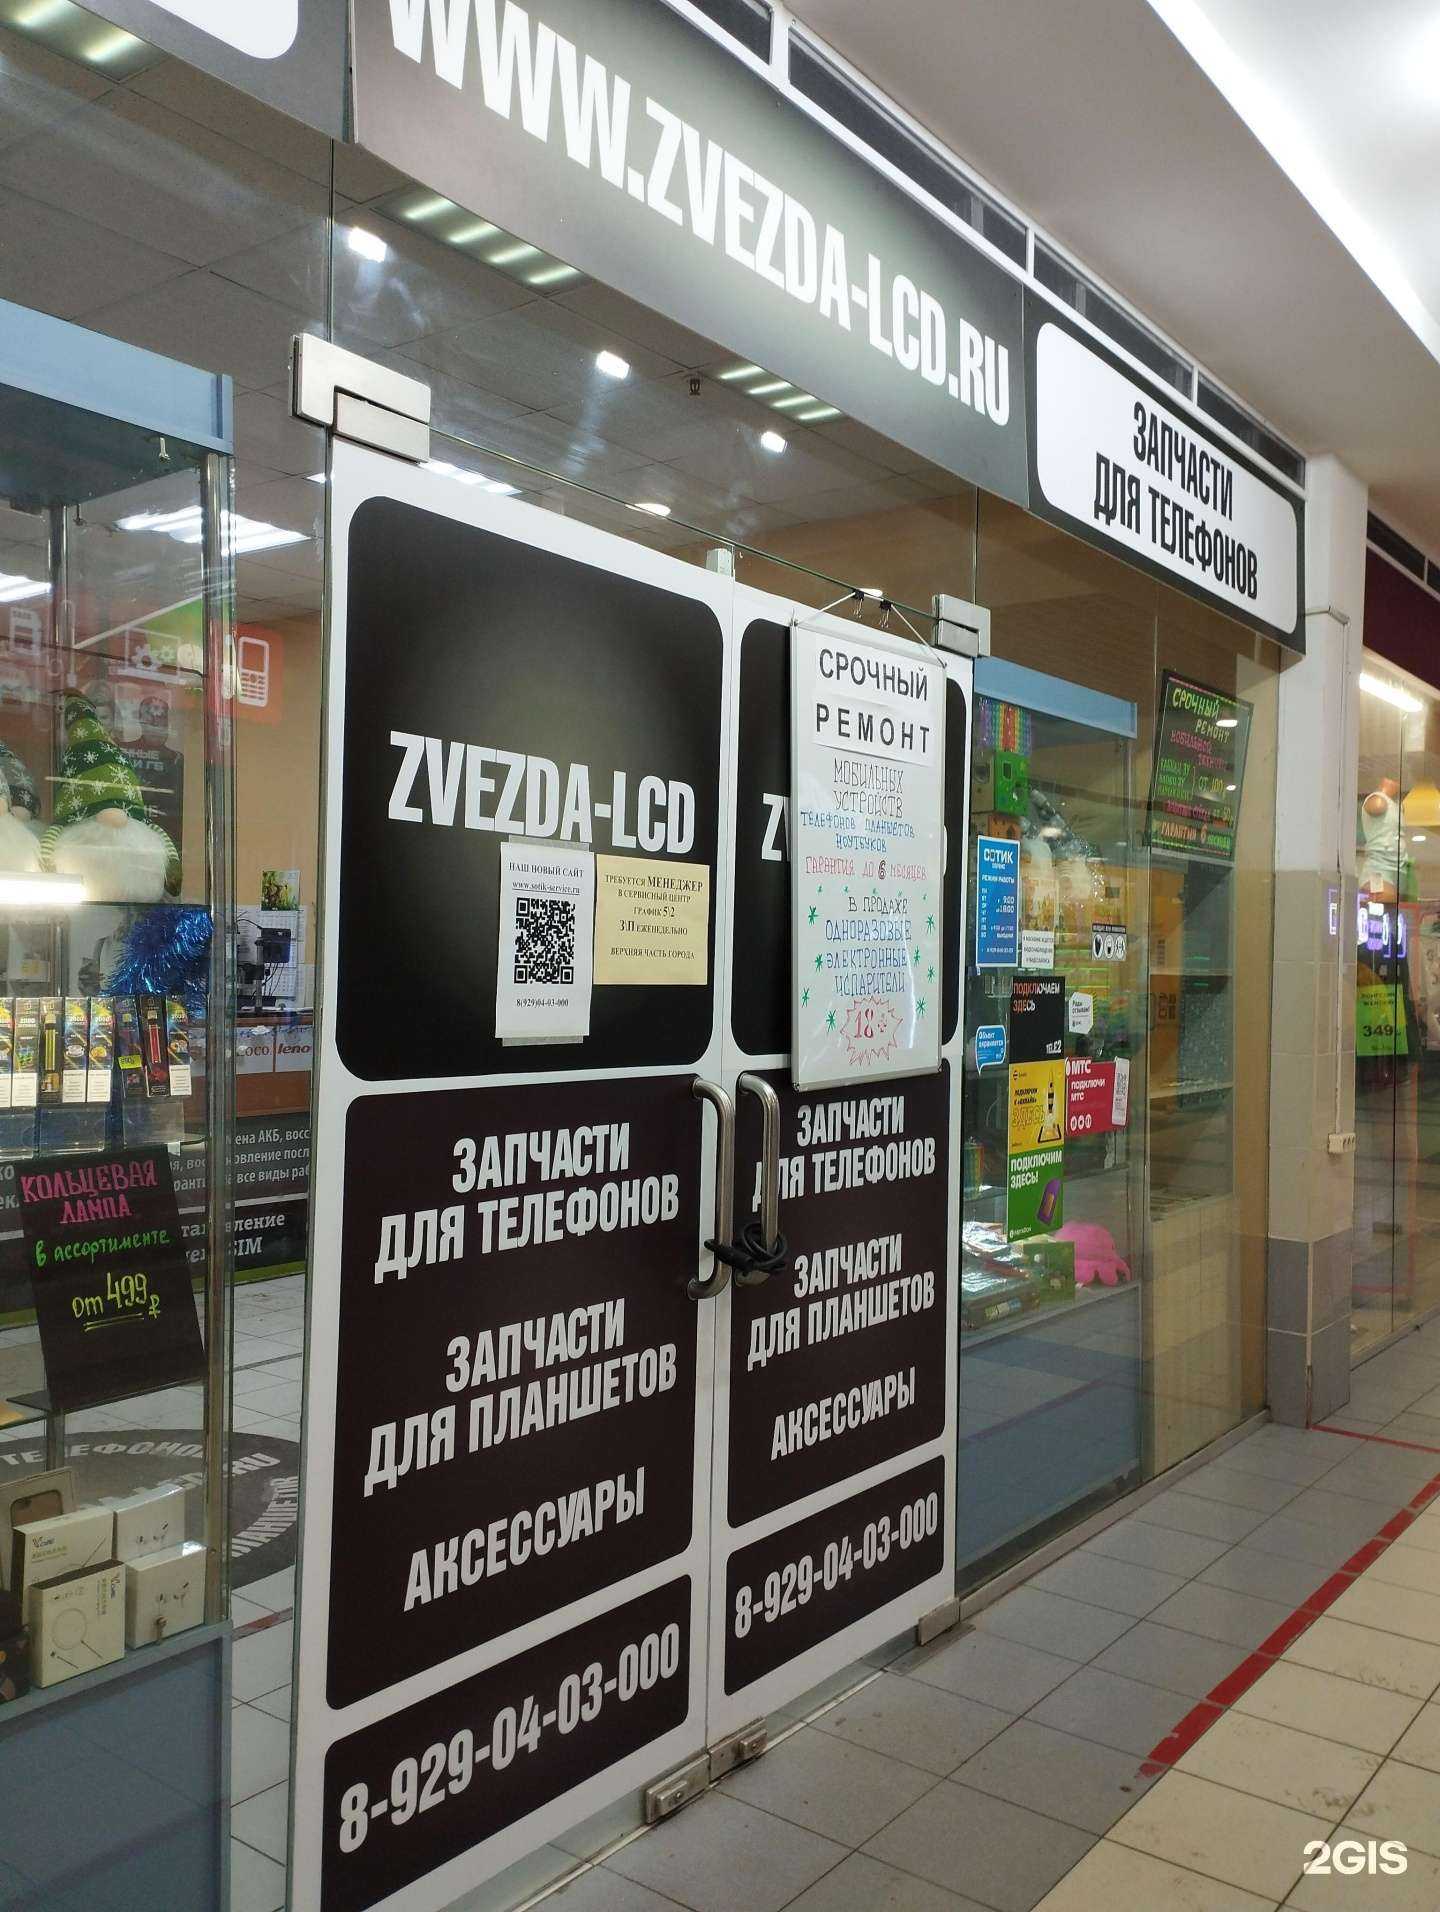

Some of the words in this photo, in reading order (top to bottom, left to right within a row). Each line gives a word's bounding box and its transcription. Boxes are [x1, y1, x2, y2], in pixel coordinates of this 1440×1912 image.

[386, 0, 1010, 427] WWW.ZVEZDA-LCD.RU
[1133, 401, 1233, 521] ЗАПЧАСТИ
[1094, 452, 1141, 534] ДЛЯ
[1149, 484, 1257, 600] ТЕЛЕФОНОВ
[819, 648, 928, 701] СРОЧНЫЙ
[1172, 687, 1220, 719] СРОЧНЫЙ
[816, 702, 930, 754] РЕМОНТ
[1195, 719, 1231, 744] РЕМОНТ
[833, 757, 904, 794] МОБИЛЬНЫХ
[388, 730, 695, 854] ZVEZDA-LCD
[833, 790, 903, 818] УСТРОЙСТВ
[801, 811, 856, 830] ТЕЛЕФОНОВ
[865, 818, 915, 838] ПЛАНШЕТОВ
[836, 833, 887, 852] НОУТБУКОВ
[983, 848, 1014, 864] СОТИК
[509, 862, 529, 873] НАШ
[531, 864, 561, 876] НОВЫЙ
[562, 867, 585, 878] САЙТ
[805, 856, 855, 875] ГАРАНТИЯ
[862, 861, 873, 877] ДО
[878, 860, 887, 880] 6
[605, 874, 646, 887] ТРЕБУЕТСЯ
[647, 876, 703, 893] МЕНЕДЖЕР
[618, 889, 623, 897] В
[624, 889, 668, 901] СЕРВИСНЫЙ
[669, 893, 691, 903] ЦЕНТР
[633, 906, 661, 916] ГРАФИК
[848, 896, 857, 912] В
[863, 896, 908, 915] ПРОДАЖЕ
[636, 924, 688, 936] ЕЖЕНЕДЕЛЬНО
[825, 919, 912, 942] ОДНОРАЗОВЫЕ
[610, 947, 643, 956] ВЕРХНЯЯ
[644, 948, 667, 958] ЧАСТЬ
[668, 949, 695, 960] ГОРОДА
[826, 948, 908, 970] ЭЛЕКТРОННЫЕ
[834, 973, 905, 996] ИСПАРИТЕЛИ
[1013, 982, 1060, 995] ПОДКЛЮЧАЕМ
[1013, 999, 1036, 1013] ЗДЕСЬ
[1071, 1059, 1092, 1074] МТС
[796, 1096, 905, 1147] ЗАПЧАСТИ
[258, 1129, 283, 1145] АКБ,
[452, 1122, 630, 1193] ЗАПЧАСТИ
[812, 1137, 935, 1194] ТЕЛЕФОНОВ
[1010, 1150, 1062, 1173] ПОДКЛЮЧИМ
[20, 1159, 158, 1203] КОЛЬЦЕВАЯ
[258, 1168, 289, 1183] виды
[1010, 1171, 1039, 1189] ЗДЕСЬ!
[60, 1194, 132, 1224] ЛАМПА
[374, 1205, 465, 1285] ДЛЯ
[477, 1174, 679, 1254] ТЕЛЕФОНОВ
[54, 1229, 171, 1264] ассортименте
[793, 1233, 902, 1299] ЗАПЧАСТИ
[72, 1297, 104, 1318] от
[747, 1306, 801, 1371] ДЛЯ
[807, 1270, 935, 1346] ПЛАНШЕТОВ
[446, 1298, 625, 1393] ЗАПЧАСТИ
[364, 1405, 457, 1498] ДЛЯ
[468, 1343, 678, 1453] ПЛАНШЕТОВ
[770, 1366, 916, 1462] АКСЕССУАРЫ
[403, 1467, 645, 1613] АКСЕССУАРЫ
[735, 1491, 938, 1639] 8-929-04-03-000
[339, 1622, 680, 1854] 8-929-04-03-000
